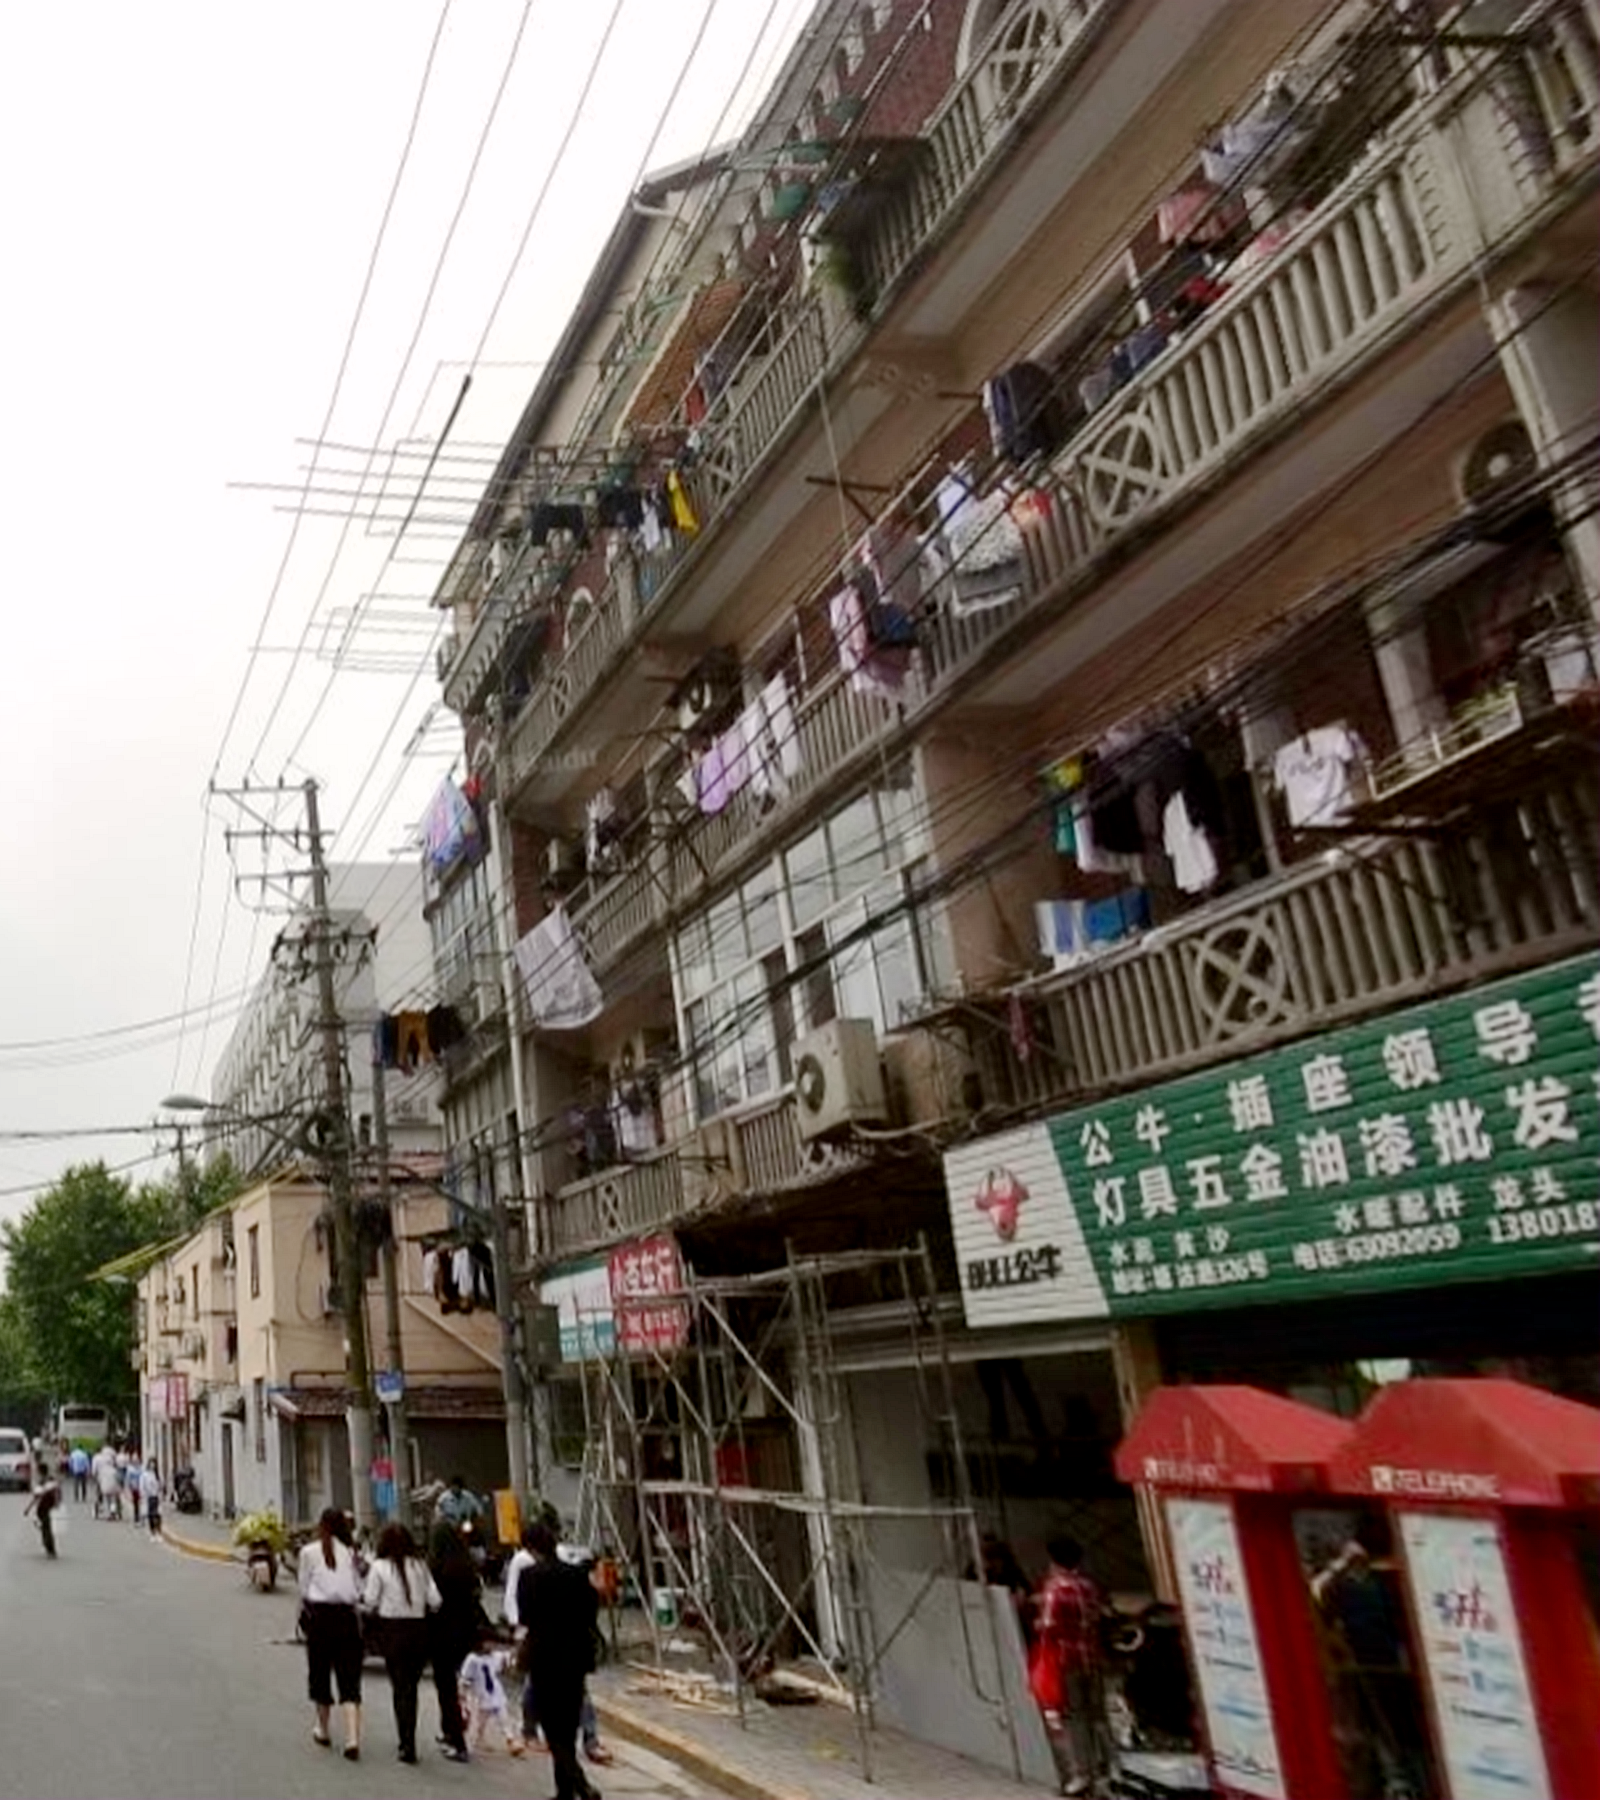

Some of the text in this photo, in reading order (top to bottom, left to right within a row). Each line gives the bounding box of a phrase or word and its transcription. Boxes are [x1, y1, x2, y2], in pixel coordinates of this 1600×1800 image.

[1095, 1076, 1578, 1228] 灯具五金油漆批发
[1334, 1183, 1465, 1235] 水暖配件
[1487, 1199, 1600, 1244] 138018
